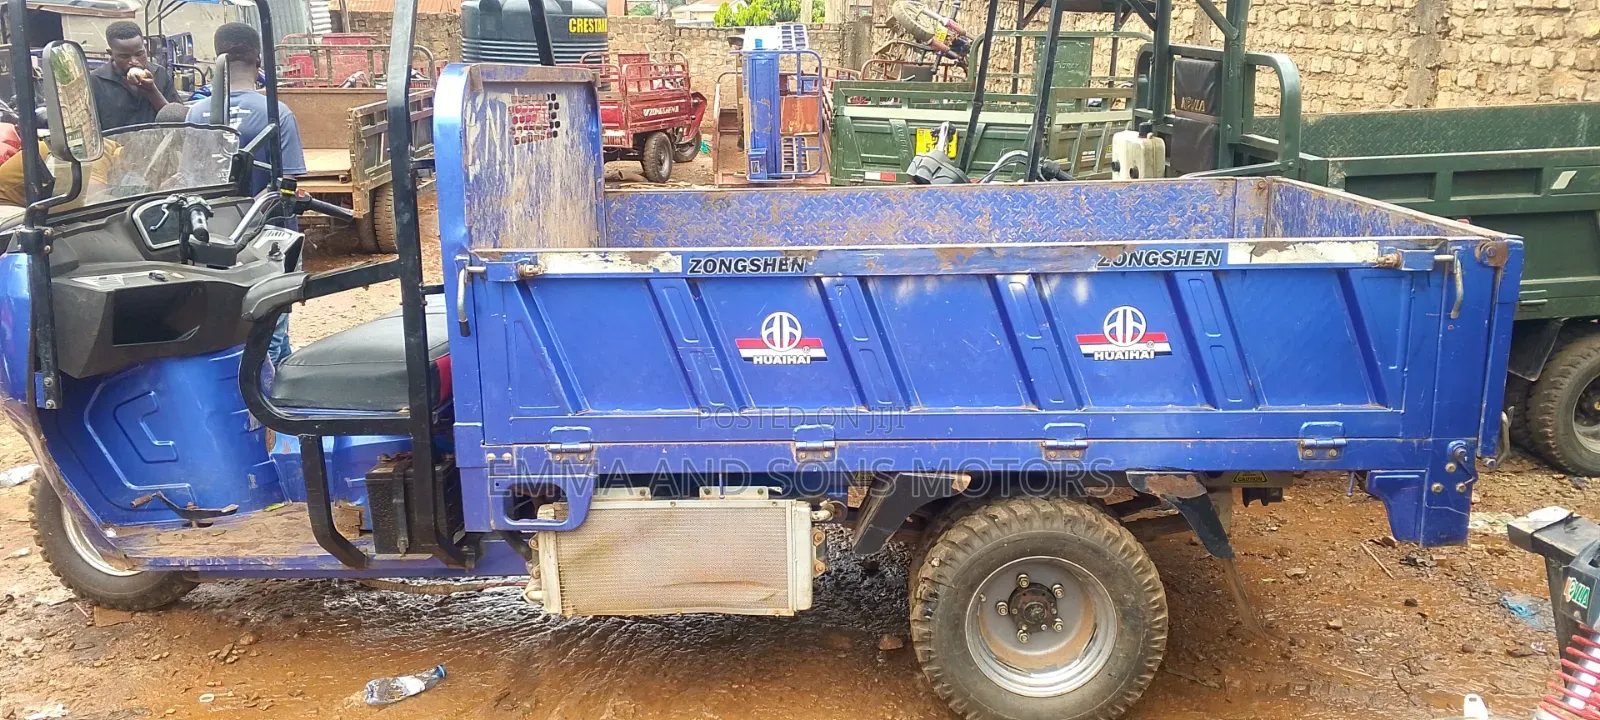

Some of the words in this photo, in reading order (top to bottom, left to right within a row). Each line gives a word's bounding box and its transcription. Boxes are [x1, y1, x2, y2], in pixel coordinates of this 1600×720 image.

[688, 256, 808, 275] ZONGSHEN
[753, 355, 811, 365] HUAIHAI
[1093, 350, 1155, 361] HUAIHAI
